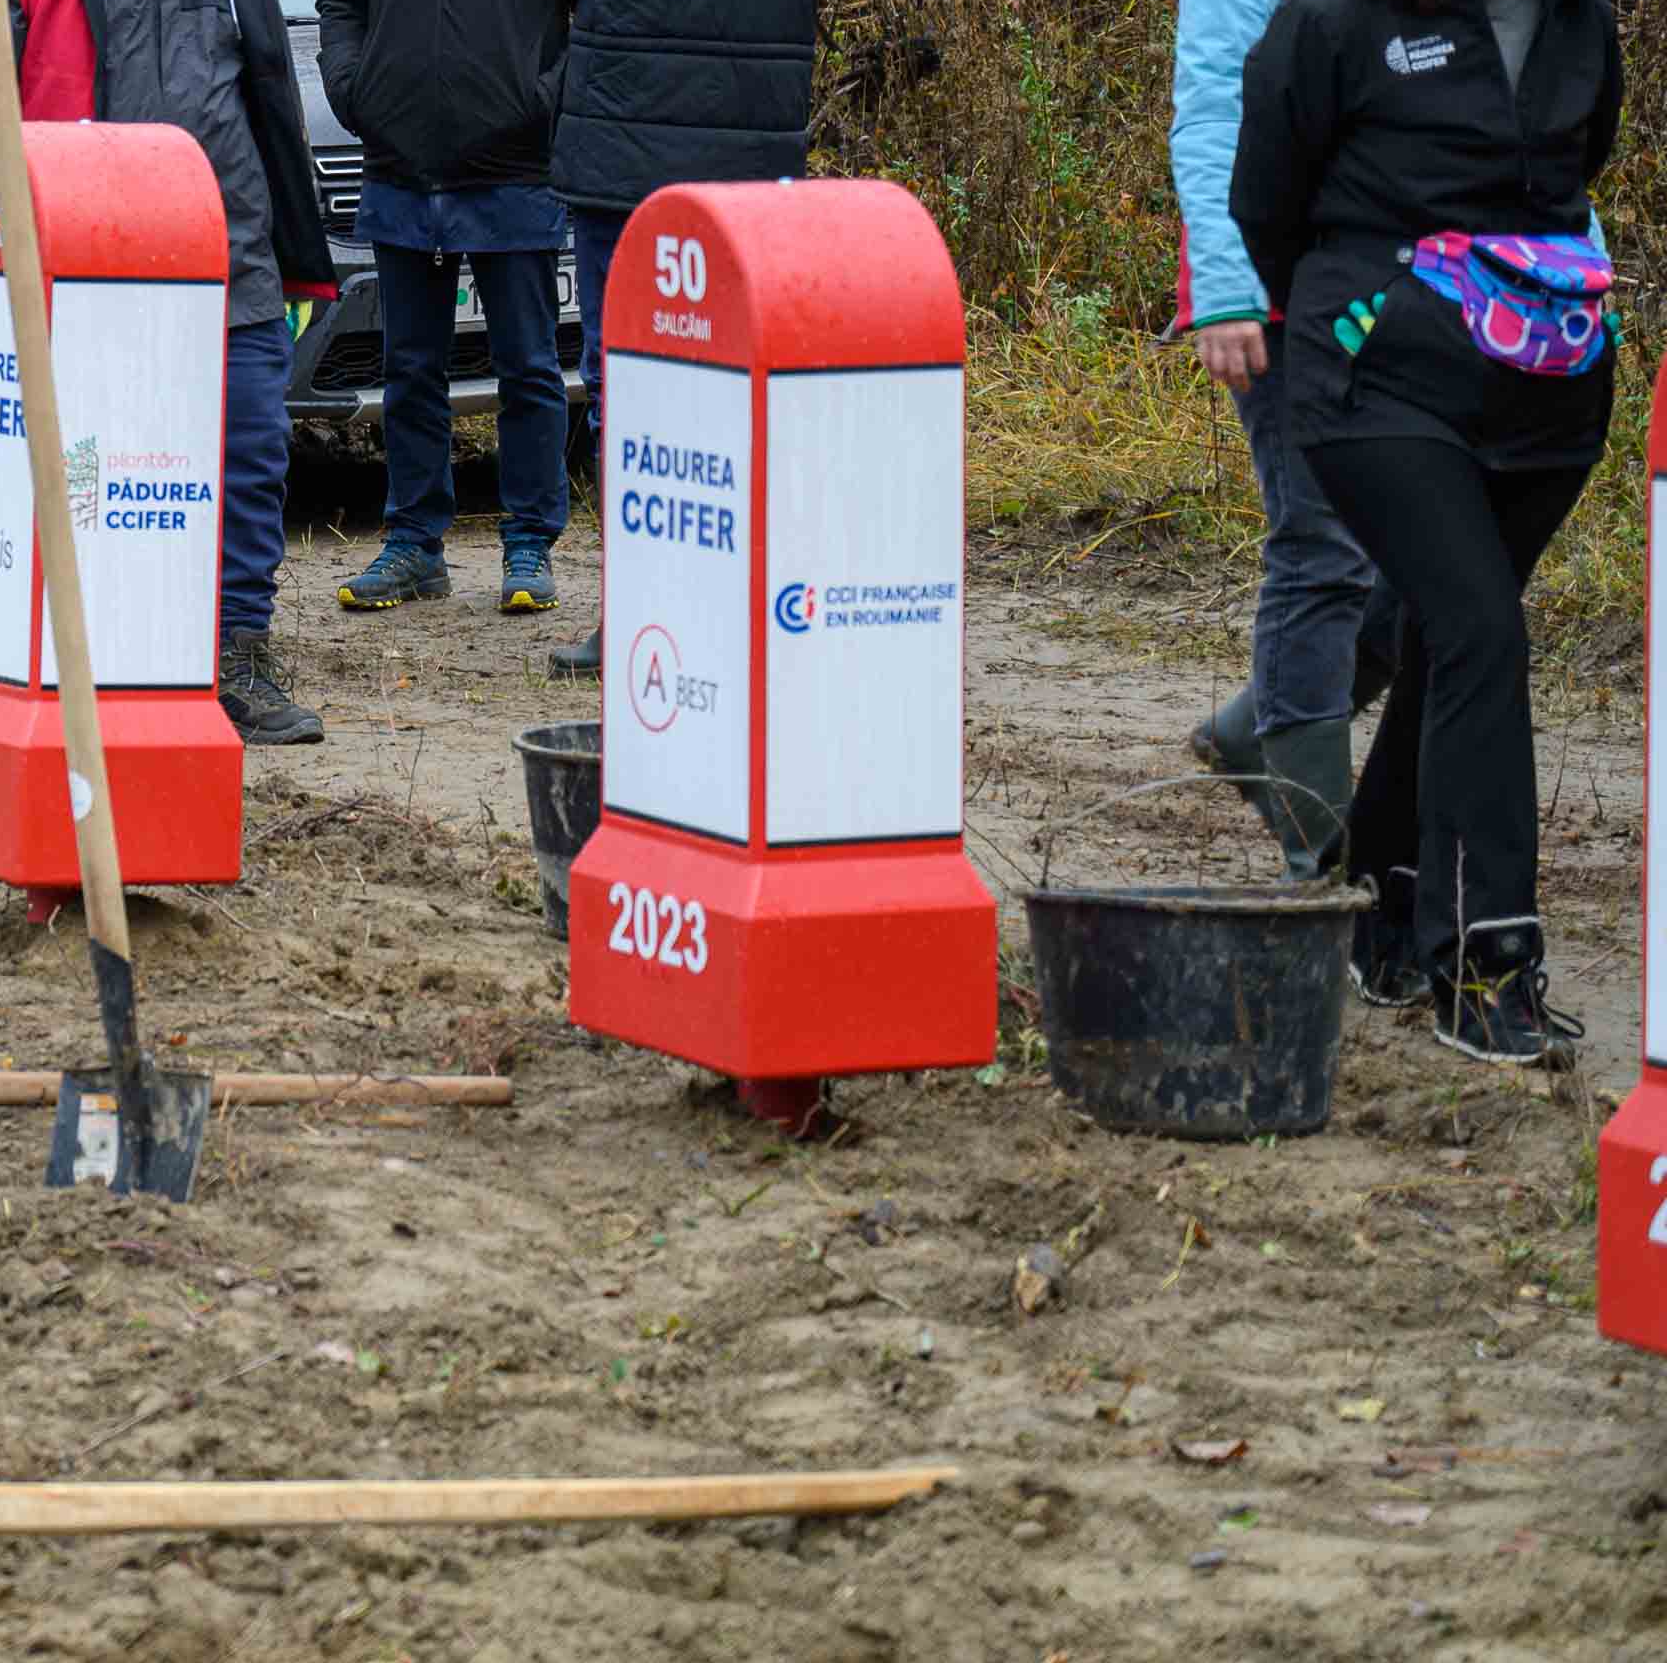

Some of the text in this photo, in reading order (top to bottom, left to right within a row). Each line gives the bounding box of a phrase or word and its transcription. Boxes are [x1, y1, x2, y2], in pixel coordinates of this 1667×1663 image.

[655, 235, 707, 303] 50
[622, 435, 735, 490] PĂDUREA
[107, 476, 212, 504] PĂDUREA
[106, 509, 187, 531] CCIFER
[621, 490, 736, 553] CCIFER
[824, 583, 957, 606] CCI FRANÇAISE
[825, 606, 943, 628] EN ROUMANIE
[676, 673, 720, 714] BEST
[609, 882, 709, 975] 2023
